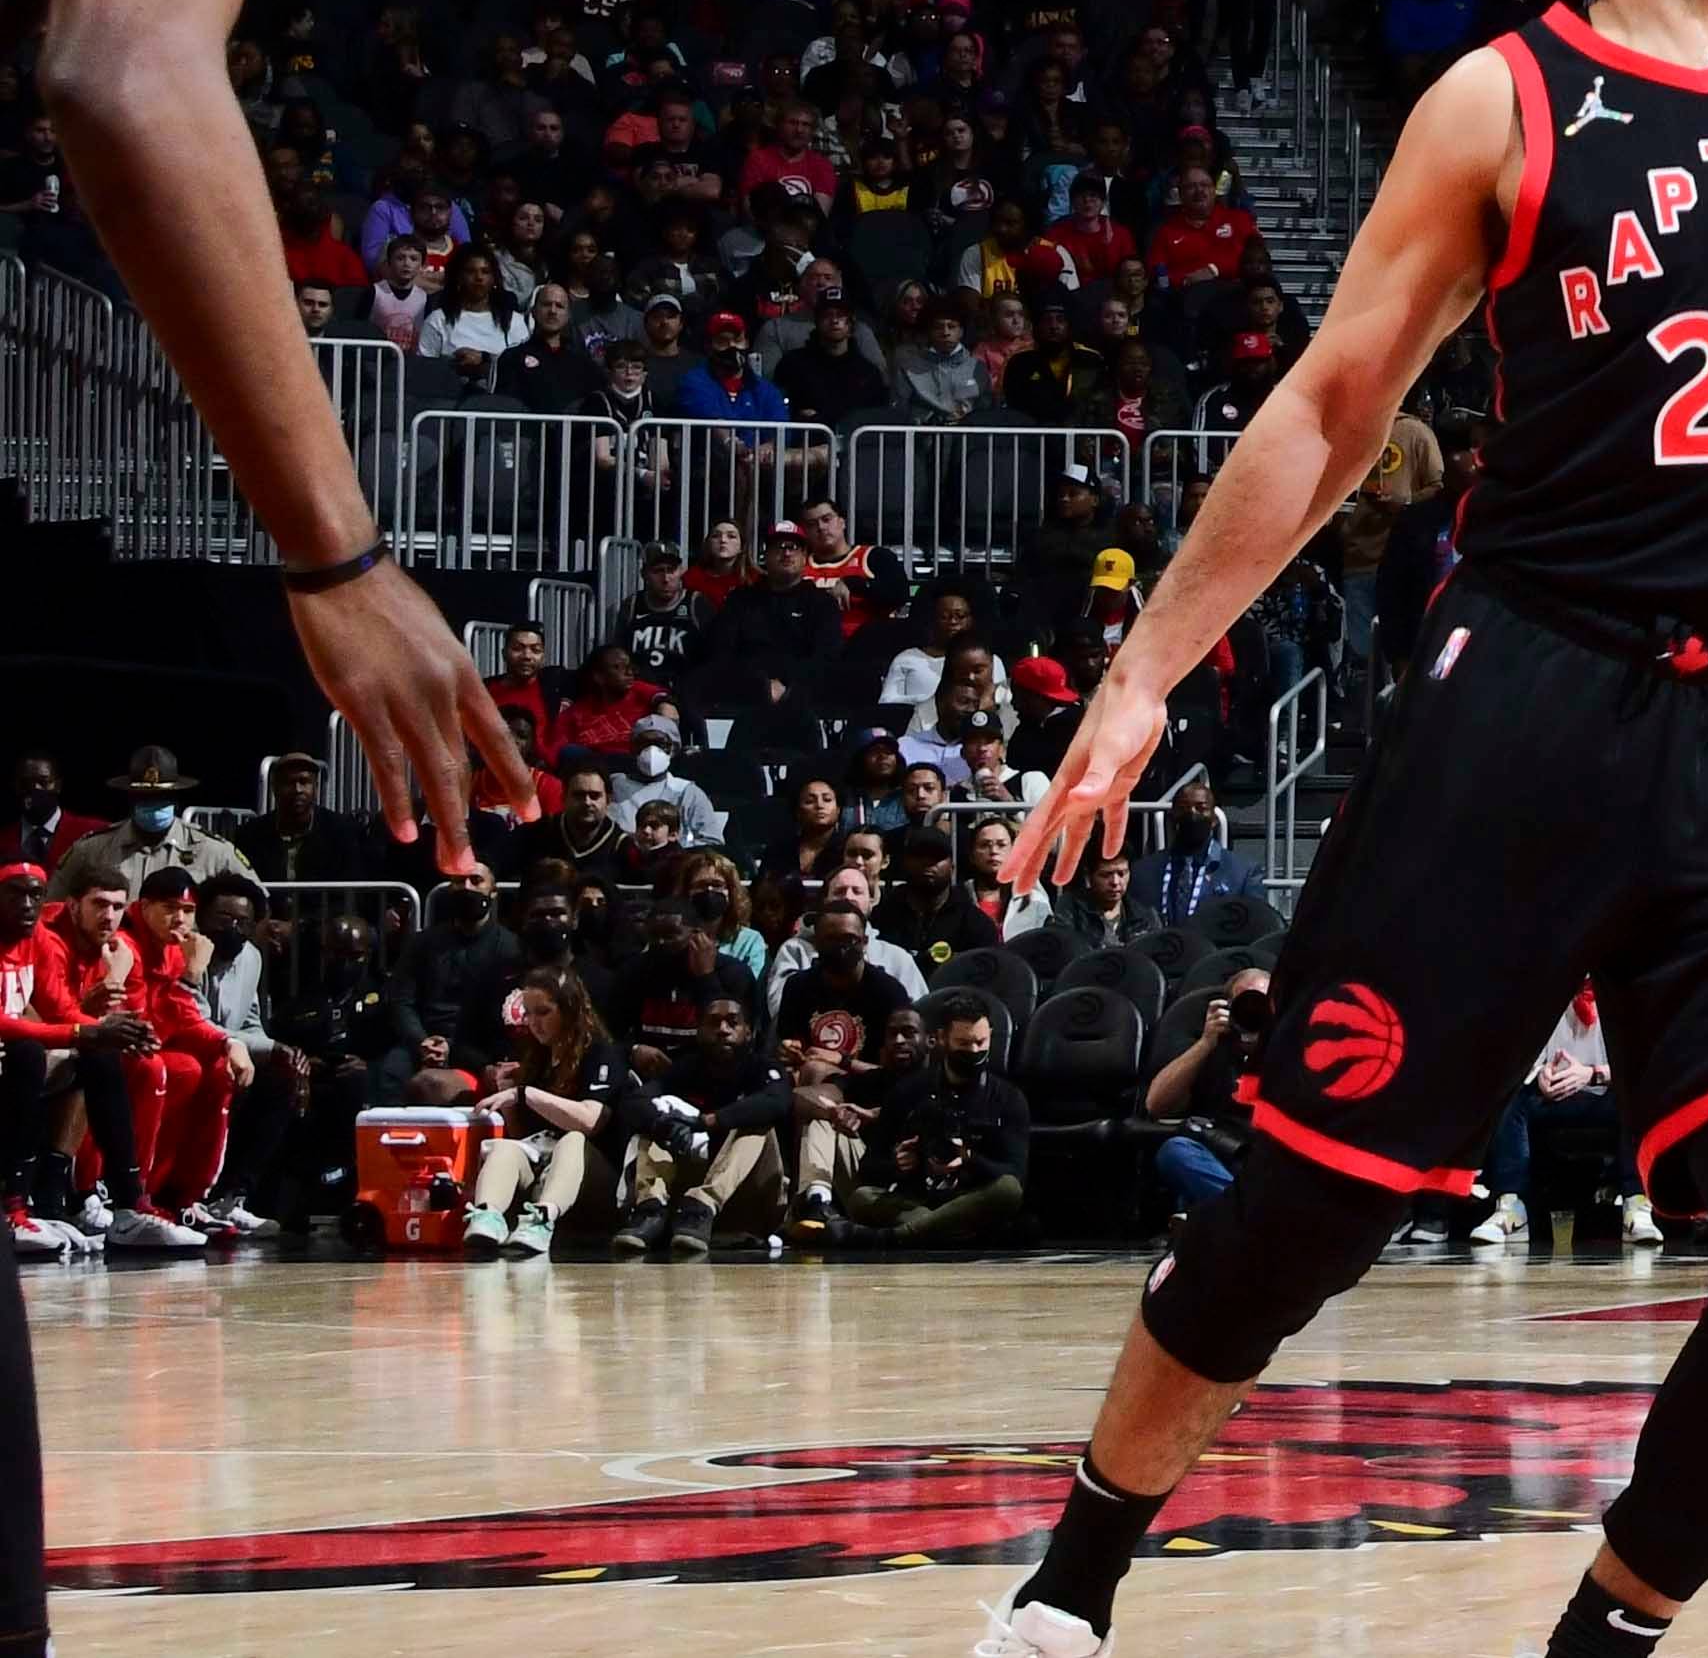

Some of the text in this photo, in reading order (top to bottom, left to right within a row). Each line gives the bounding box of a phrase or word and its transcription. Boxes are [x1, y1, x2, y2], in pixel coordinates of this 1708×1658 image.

[632, 625, 689, 655] MLK
[648, 650, 665, 668] 5
[405, 1216, 422, 1241] G
